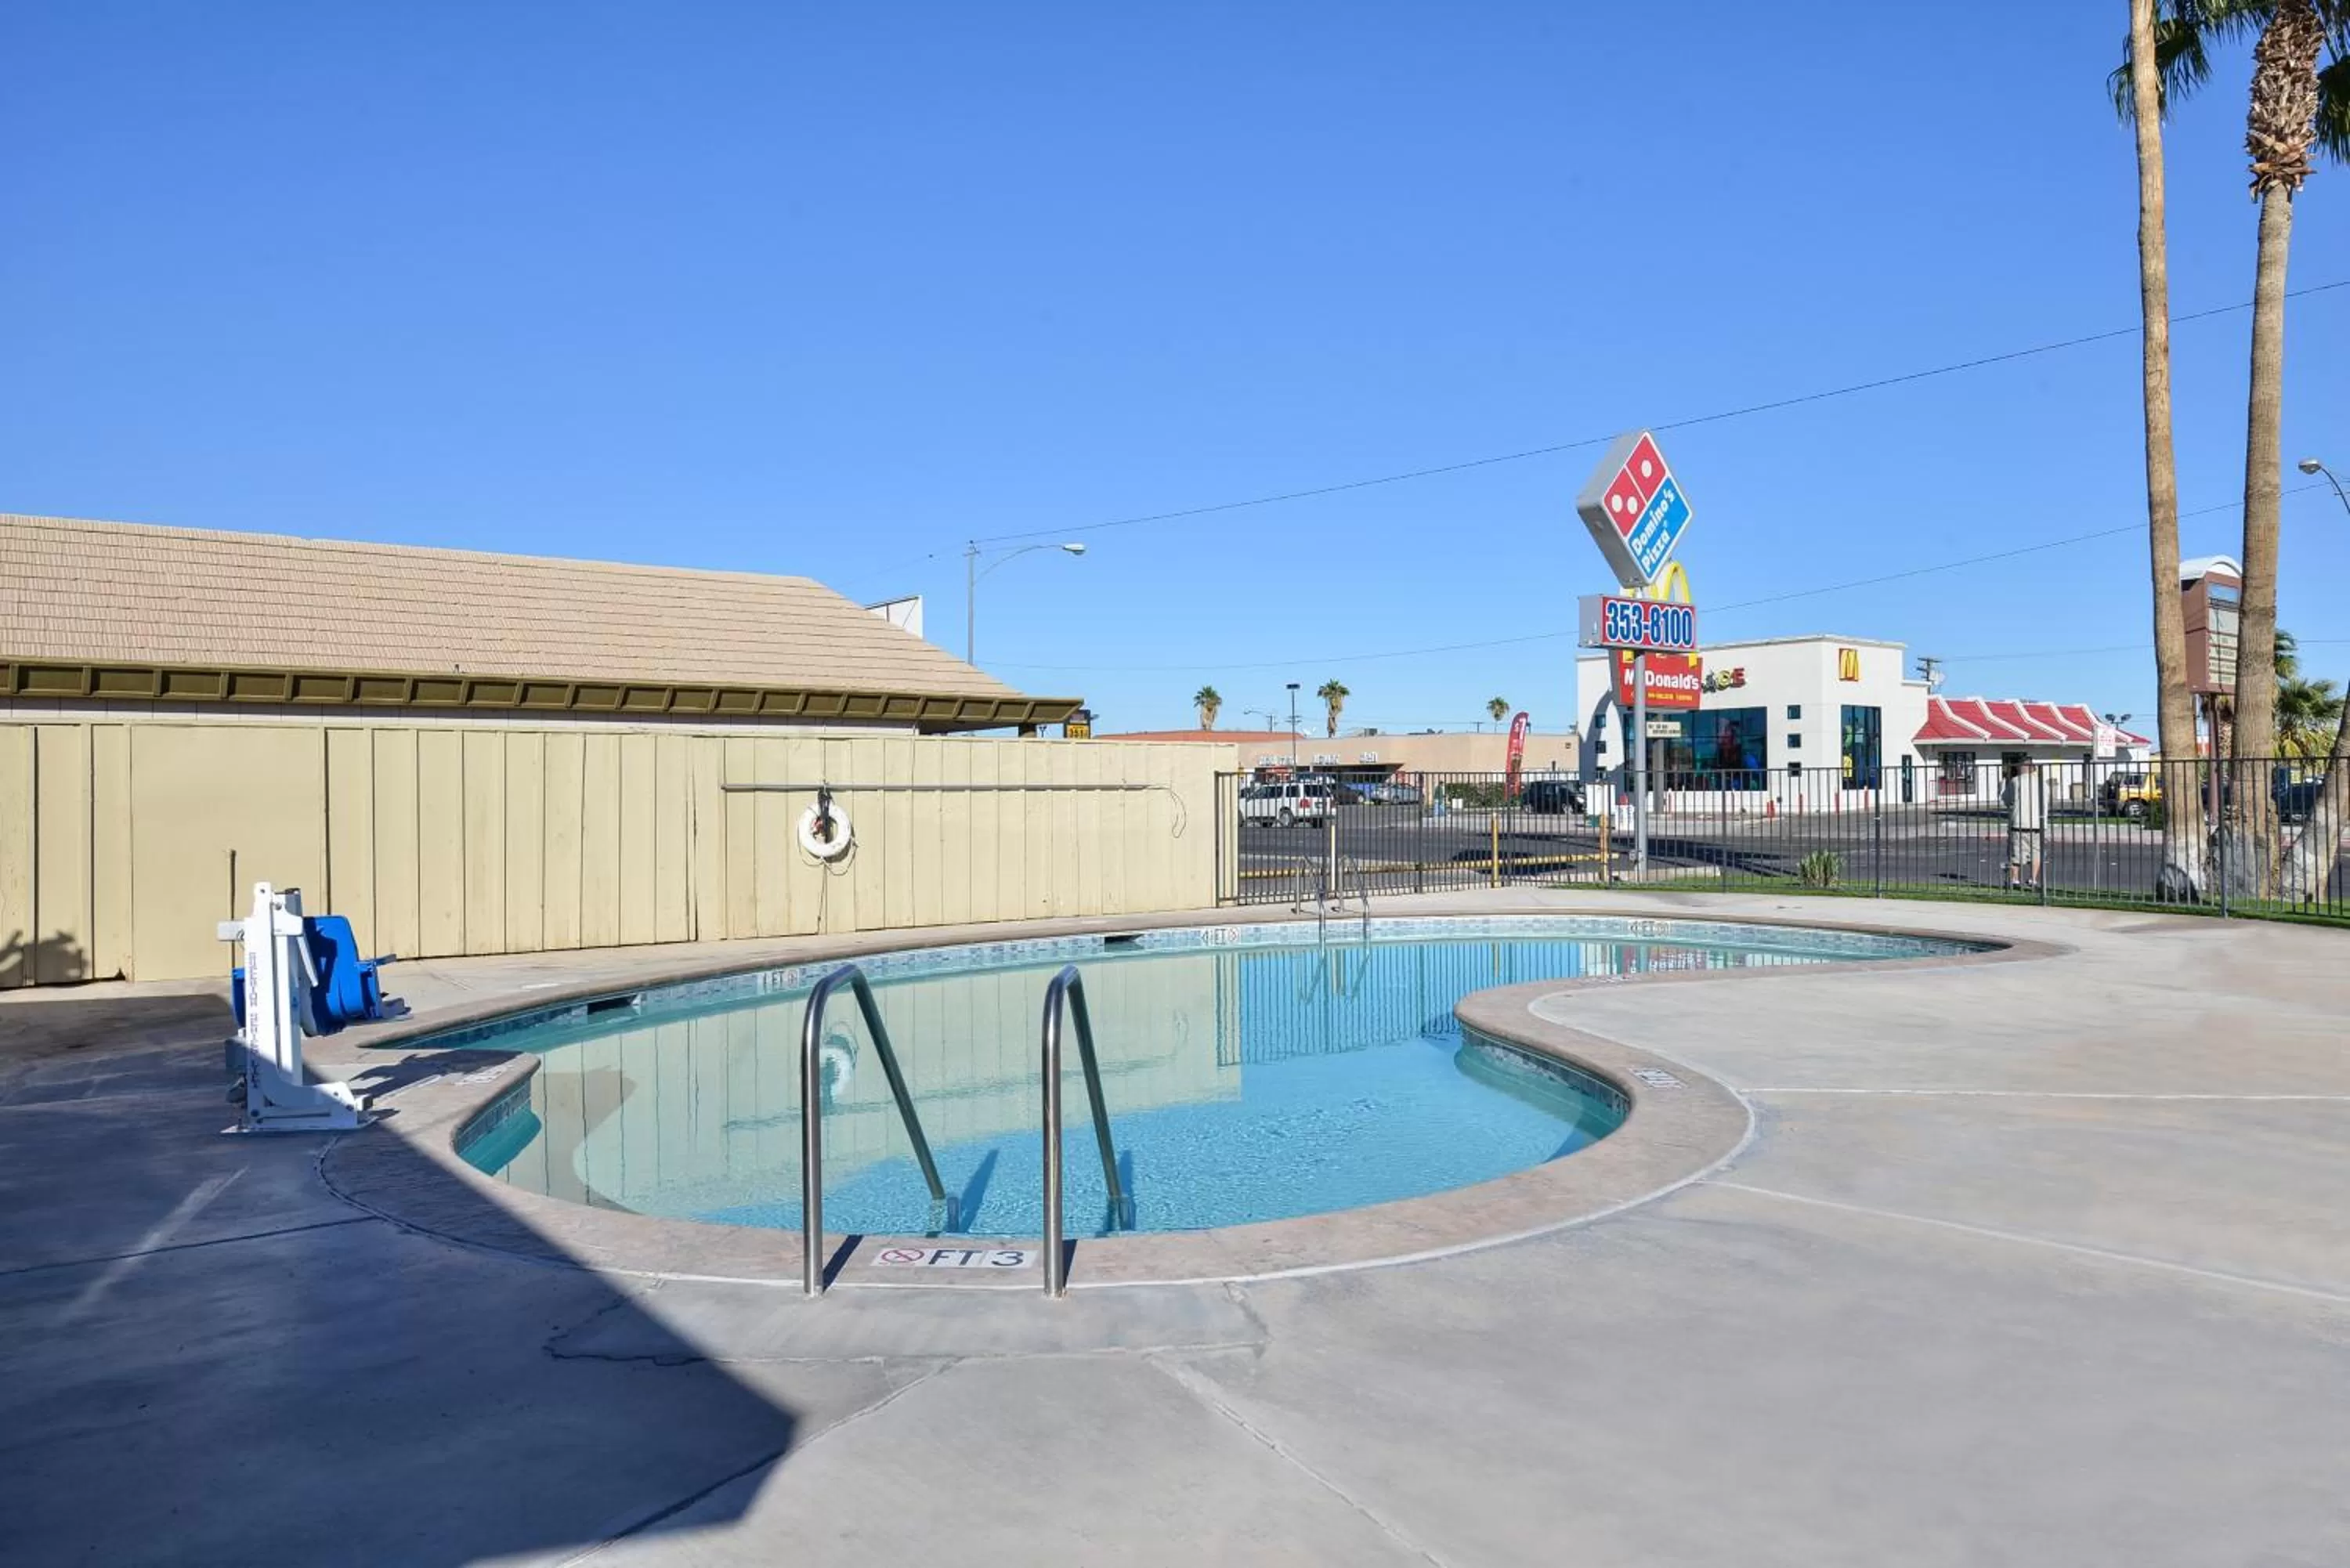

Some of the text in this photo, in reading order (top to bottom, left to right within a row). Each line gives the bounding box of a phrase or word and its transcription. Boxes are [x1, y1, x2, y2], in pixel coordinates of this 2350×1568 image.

[1632, 488, 1675, 556] Domino's
[1641, 529, 1671, 573] Pizza
[1607, 600, 1692, 646] 353-8100
[1624, 668, 1699, 690] MDonald's
[928, 1249, 1024, 1266] FT 3
